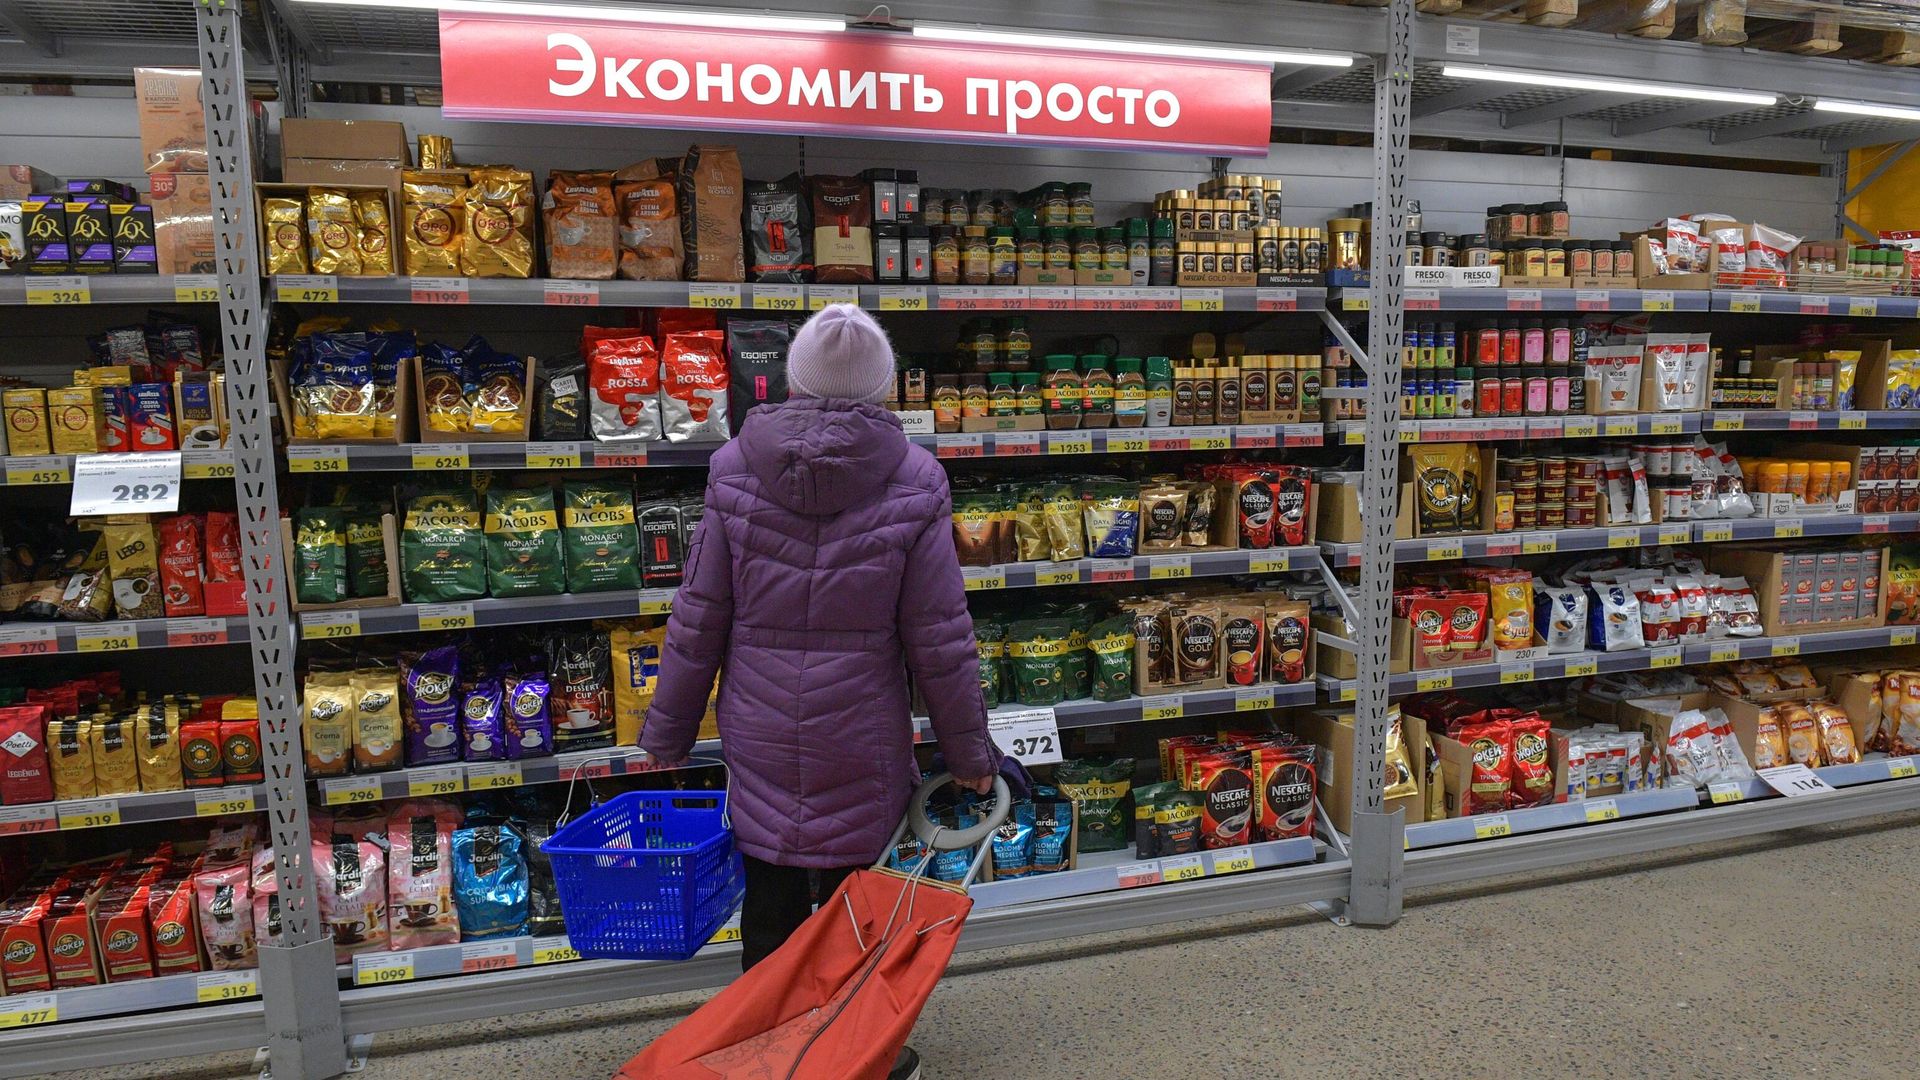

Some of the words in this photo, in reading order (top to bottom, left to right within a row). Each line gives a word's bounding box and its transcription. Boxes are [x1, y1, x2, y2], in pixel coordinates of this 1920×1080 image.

[546, 33, 943, 114] Экономить
[966, 77, 1180, 134] просто
[752, 204, 797, 213] EGOISTE
[422, 222, 450, 233] ORO
[478, 218, 507, 230] ORO
[769, 254, 790, 262] NOIR
[1415, 270, 1445, 279] FRESCO
[1464, 271, 1492, 280] FRESCO
[52, 292, 80, 303] 324
[192, 290, 218, 300] 152
[302, 291, 329, 302] 472
[426, 292, 459, 302] 1199
[557, 294, 589, 305] 1782
[703, 298, 733, 308] 1309
[767, 299, 796, 310] 1399
[899, 299, 920, 308] 399
[955, 300, 977, 309] 236
[1001, 300, 1022, 309] 322
[1047, 300, 1068, 309] 322
[1092, 301, 1112, 310] 322
[1119, 301, 1138, 310] 349
[1154, 301, 1174, 310] 349
[1200, 302, 1217, 311] 124
[1272, 303, 1289, 311] 275
[741, 351, 779, 359] EGOISTE
[608, 378, 648, 388] ROSSA
[677, 374, 713, 384] ROSSA
[1054, 389, 1080, 398] JACOBS
[1086, 389, 1113, 397] JACOBS
[1122, 390, 1145, 398] JACOBS
[902, 417, 922, 425] GOLD
[1578, 428, 1592, 436] 999
[1618, 426, 1633, 434] 116
[1124, 441, 1143, 450] 322
[1165, 441, 1182, 449] 621
[1206, 439, 1225, 448] 236
[955, 448, 975, 457] 349
[1013, 446, 1033, 454] 236
[1060, 444, 1086, 453] 1253
[313, 460, 339, 471] 354
[435, 457, 460, 468] 624
[549, 457, 570, 467] 791
[607, 456, 637, 466] 1453
[208, 467, 234, 477] 209
[32, 472, 61, 483] 452
[112, 484, 169, 501] 282
[415, 515, 469, 527] JACOBS
[573, 510, 625, 524] JACOBS
[497, 515, 547, 529] JACOBS
[644, 523, 676, 531] EGOISTE
[421, 536, 466, 544] MONARCH
[580, 533, 622, 542] MONARCH
[504, 539, 544, 548] MONARCH
[1537, 544, 1551, 552] 149
[115, 541, 145, 560] LEBO
[1441, 550, 1457, 558] 444
[1266, 563, 1283, 571] 179
[1108, 572, 1126, 581] 479
[1167, 569, 1185, 577] 184
[1054, 574, 1073, 583] 299
[980, 580, 999, 589] 189
[441, 618, 466, 628] 999
[327, 626, 352, 637] 270
[191, 634, 217, 644] 309
[20, 643, 47, 654] 270
[102, 639, 129, 650] 234
[1187, 643, 1212, 653] GOLD
[1021, 644, 1060, 655] JACOBS
[1516, 651, 1531, 659] 230
[562, 659, 595, 670] Jardin
[1663, 658, 1676, 666] 147
[1578, 667, 1592, 675] 399
[1514, 673, 1529, 681] 549
[566, 683, 599, 693] DESSERT
[1431, 680, 1447, 689] 229
[1251, 700, 1269, 708] 179
[1159, 709, 1177, 718] 399
[363, 724, 389, 732] Crema
[101, 736, 125, 745] Jardin
[146, 732, 170, 741] Jardin
[315, 732, 340, 740] Crema
[5, 739, 33, 749] Poetti
[58, 742, 81, 750] Jardin
[1013, 736, 1054, 757] 372
[491, 777, 515, 786] 436
[1792, 778, 1823, 791] 114
[432, 782, 456, 793] 789
[1074, 785, 1116, 797] JACOBS
[350, 791, 374, 801] 296
[1276, 793, 1310, 803] CLASSIC
[220, 803, 245, 813] 359
[1215, 800, 1248, 810] CLASSIC
[1167, 809, 1195, 821] JACOBS
[1604, 811, 1614, 819] 46
[85, 815, 111, 826] 319
[19, 821, 45, 832] 477
[1168, 826, 1195, 834] MILLICANO
[1490, 827, 1505, 835] 659
[407, 852, 441, 863] Jardin
[468, 852, 503, 863] Jardin
[937, 855, 968, 865] COLOMBIA
[1231, 861, 1248, 870] 649
[1180, 869, 1198, 878] 634
[1135, 876, 1153, 885] 749
[157, 927, 185, 942] ЖОКЕЙ
[54, 940, 84, 954] ЖОКЕЙ
[108, 935, 138, 950] ЖОКЕЙ
[4, 945, 36, 961] ЖОКЕЙ
[547, 950, 577, 960] 2659
[374, 969, 406, 980] 1099
[222, 986, 247, 997] 319
[21, 1011, 48, 1023] 477
